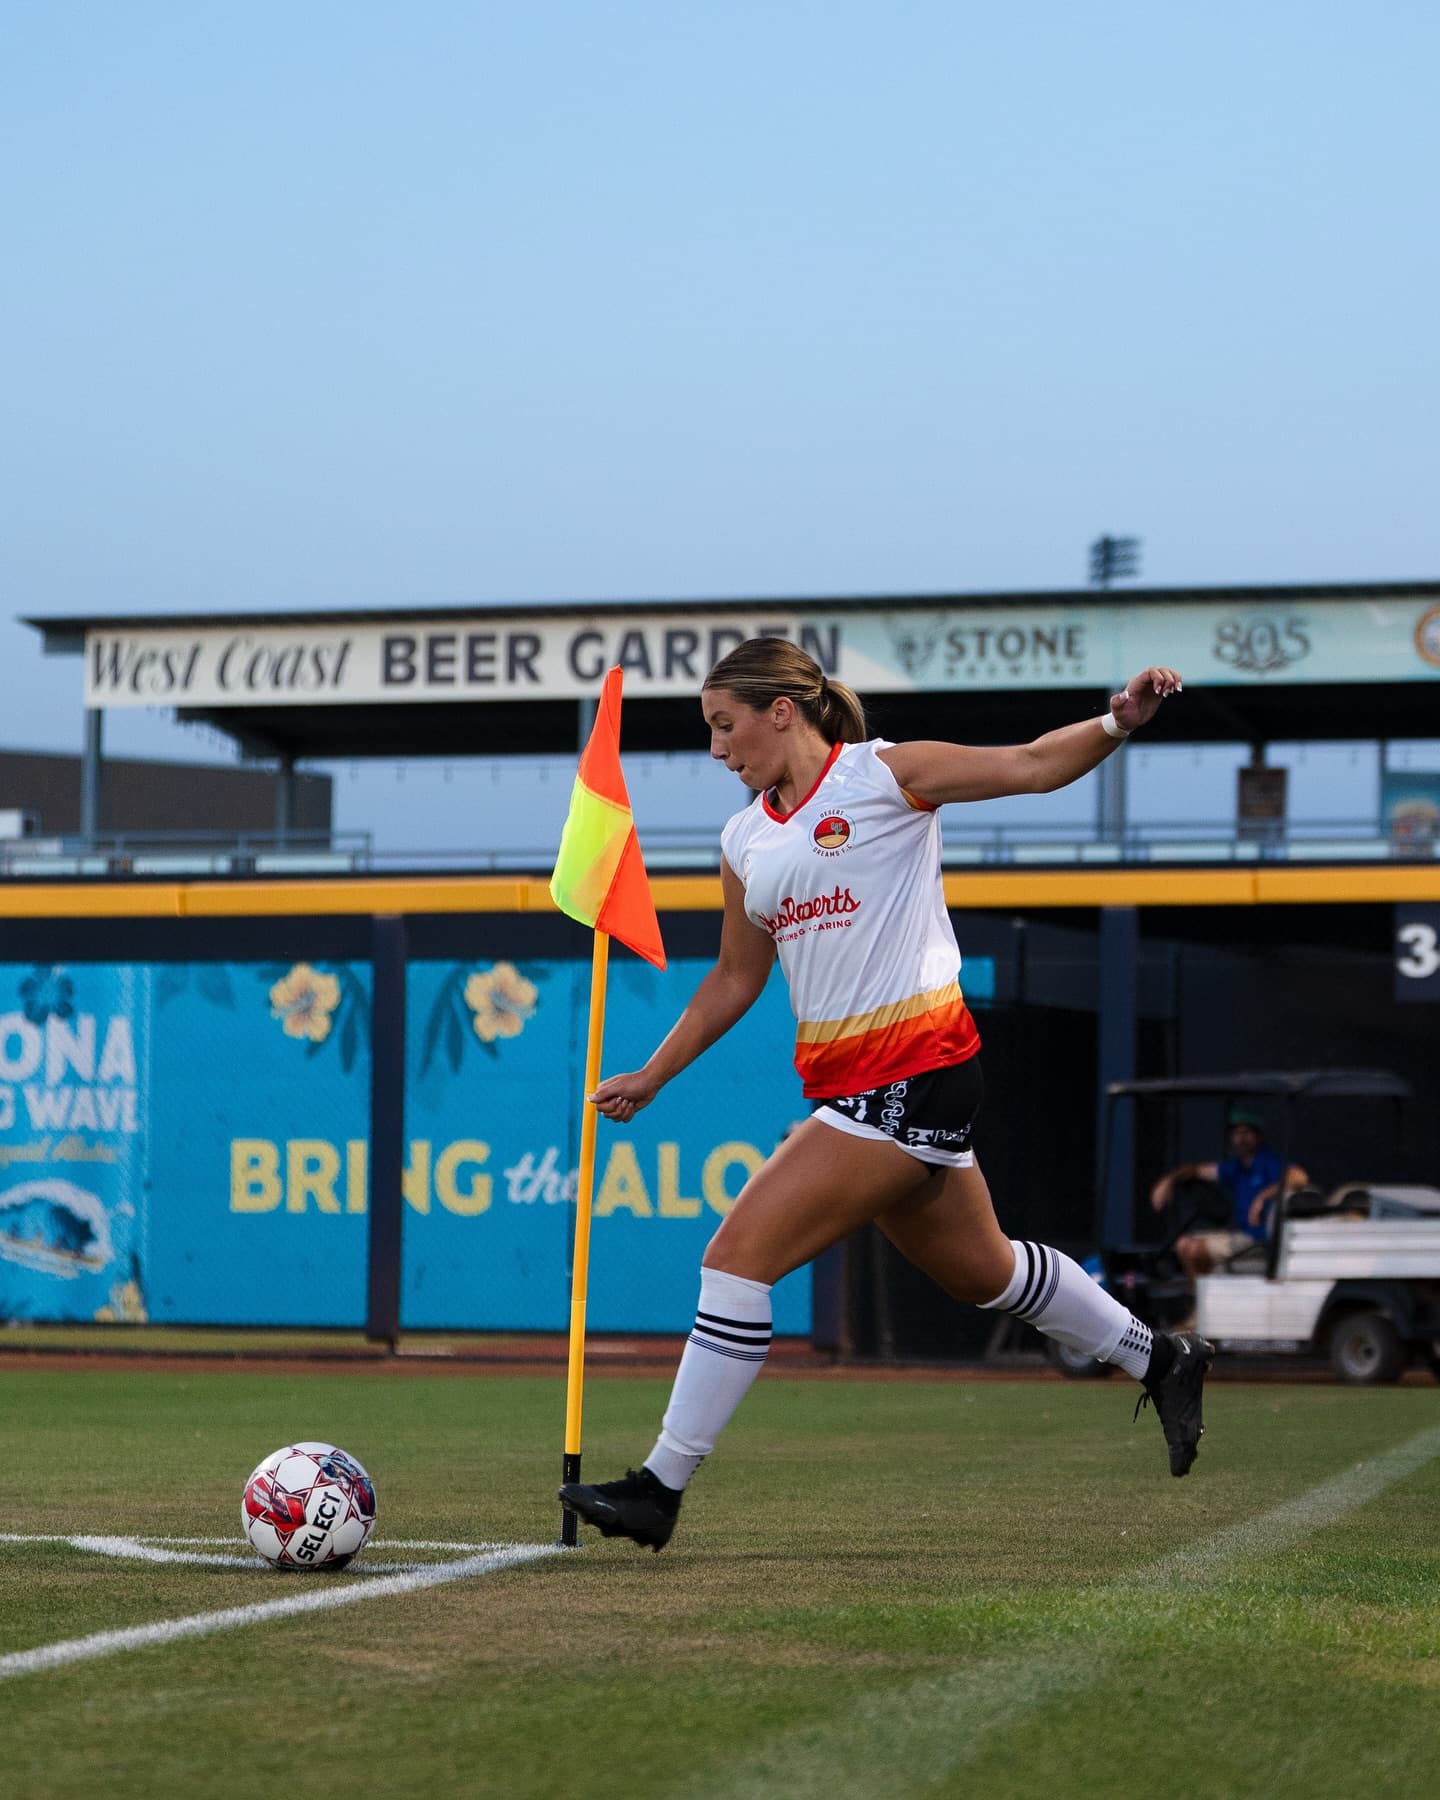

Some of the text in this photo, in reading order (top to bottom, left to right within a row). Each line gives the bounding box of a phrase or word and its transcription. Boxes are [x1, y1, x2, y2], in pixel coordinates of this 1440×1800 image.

[89, 624, 839, 695] West Coast BEER GARDN
[945, 624, 1086, 663] STONE
[1212, 607, 1312, 675] 805
[820, 809, 844, 818] DESERT
[1397, 923, 1440, 979] 3
[296, 1490, 341, 1562] SELECT
